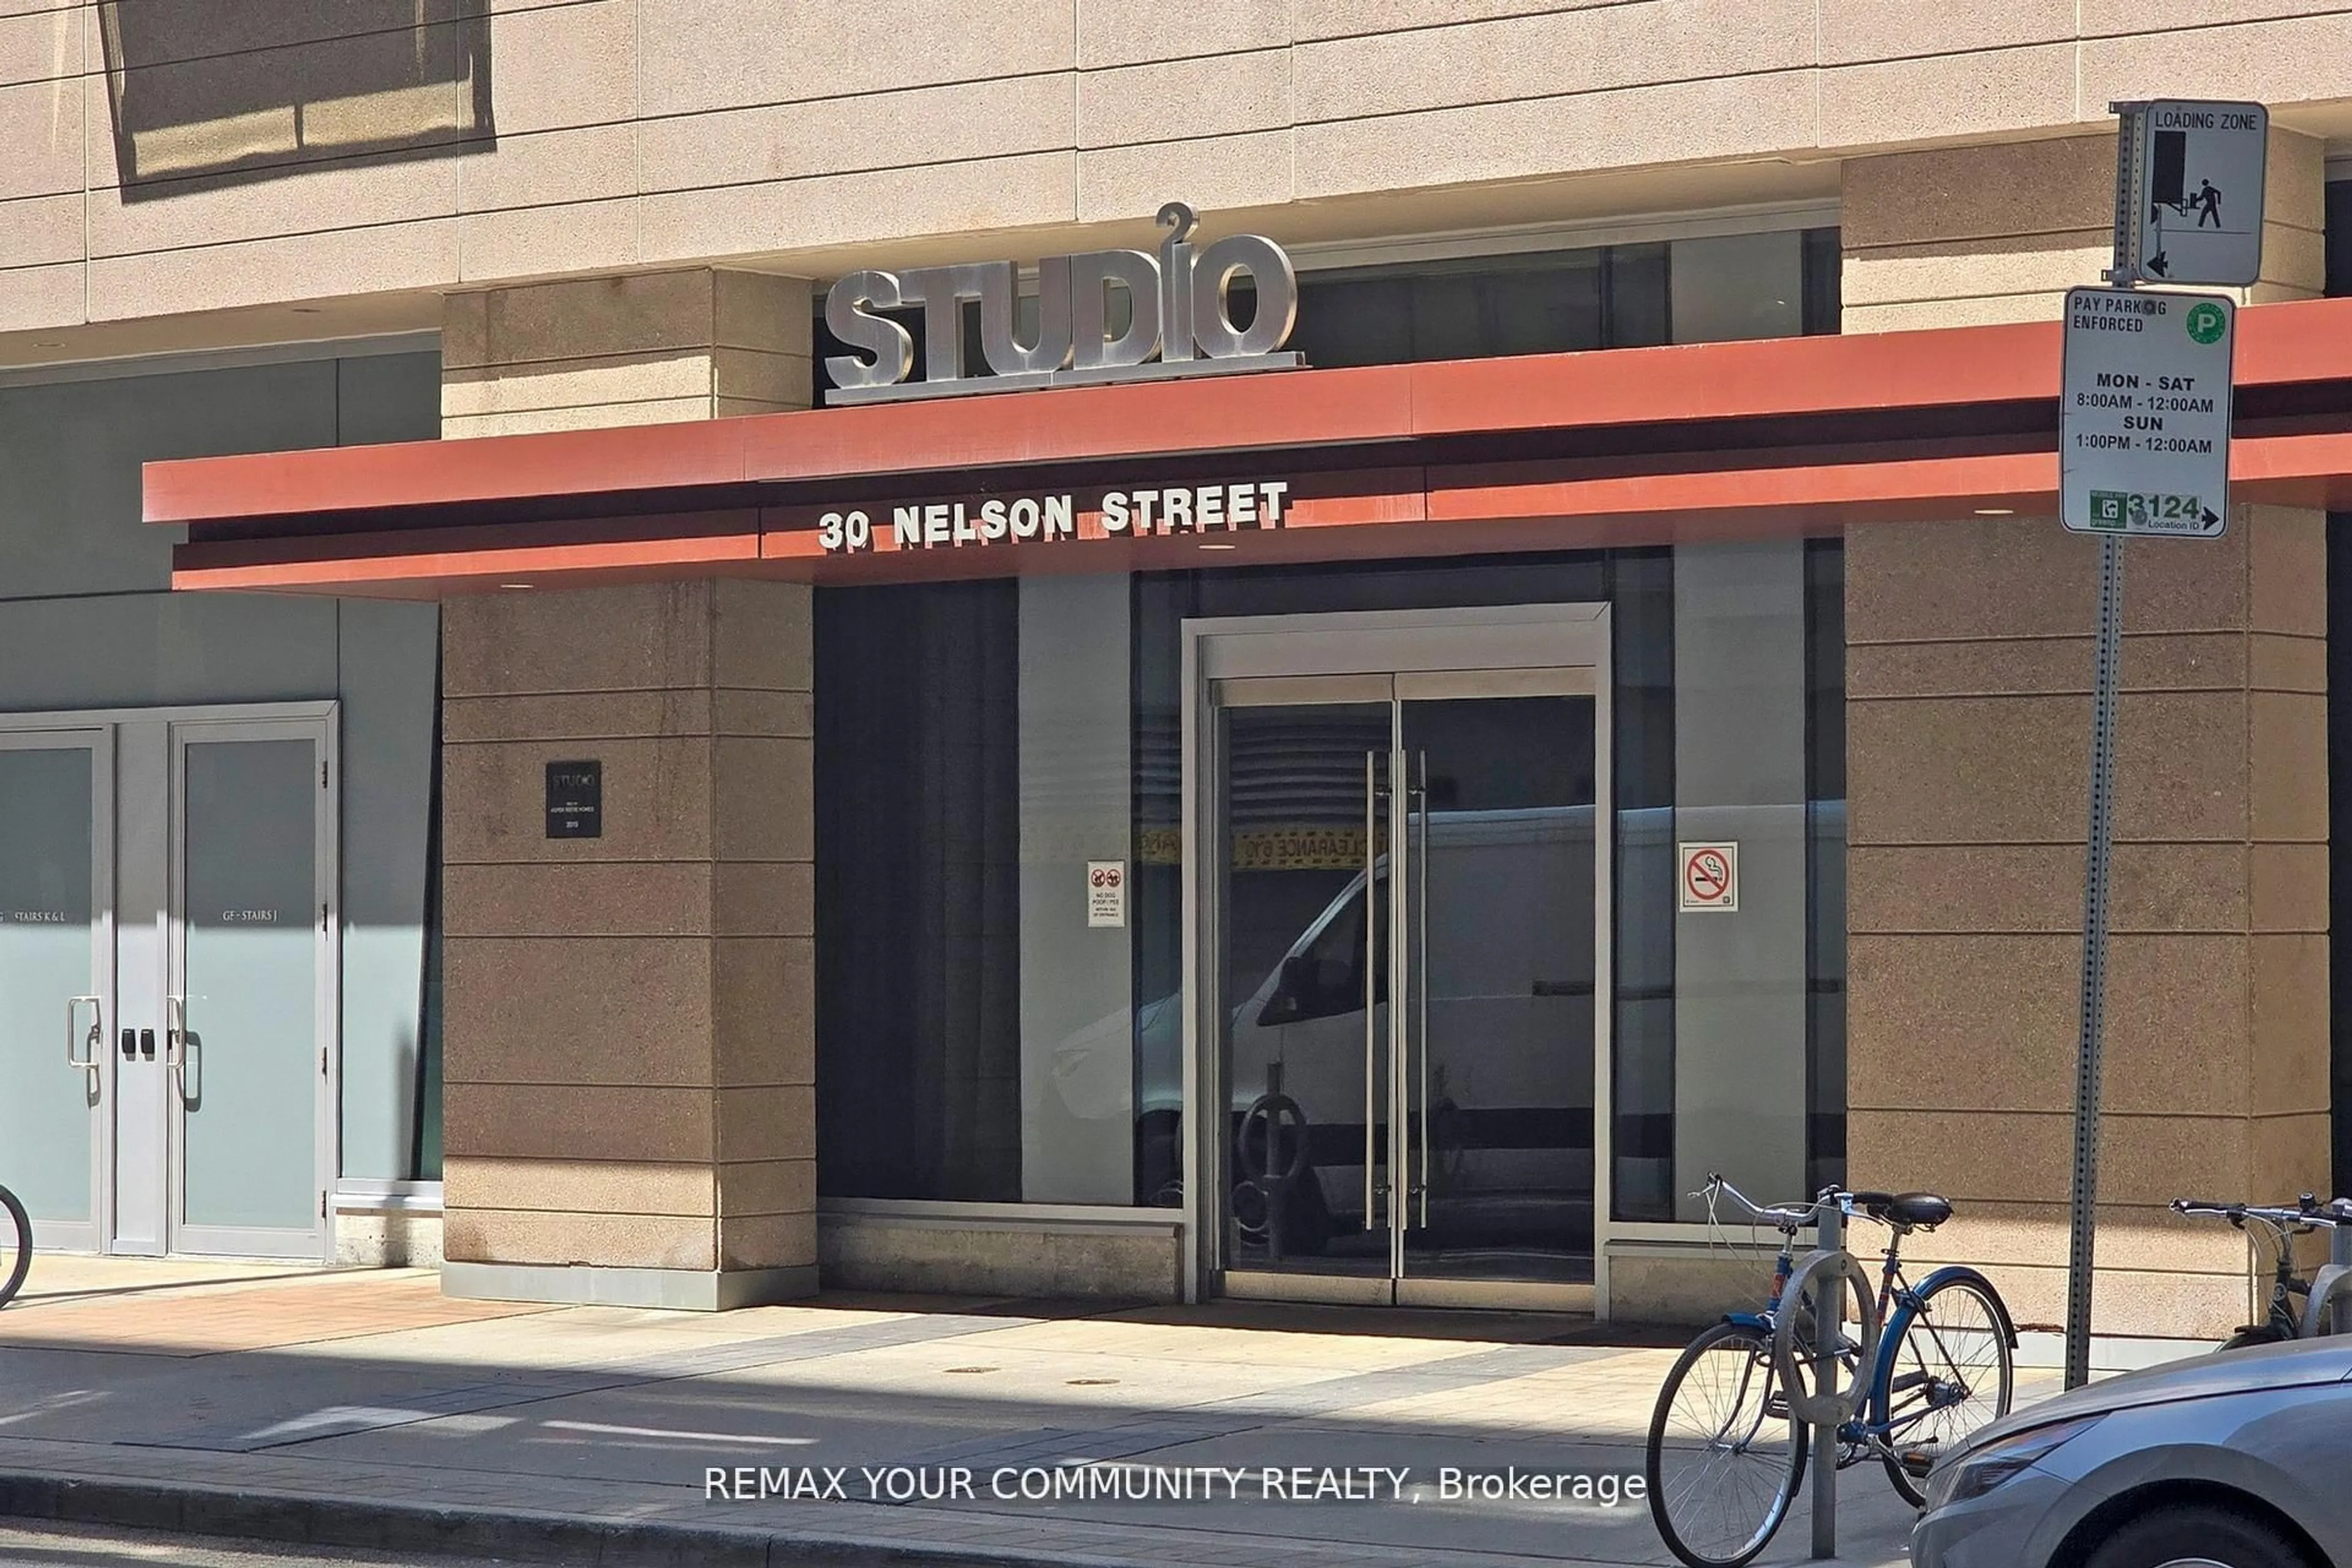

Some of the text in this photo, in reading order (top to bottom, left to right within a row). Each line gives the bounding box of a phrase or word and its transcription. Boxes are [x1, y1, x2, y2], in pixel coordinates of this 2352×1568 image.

[2155, 112, 2257, 130] LOADING ZONE
[2074, 296, 2166, 315] PAY PARKG
[2074, 315, 2143, 332] ENFORCED
[2198, 313, 2216, 333] P
[2097, 373, 2139, 388] MON
[2158, 375, 2195, 391] SAT
[2077, 393, 2132, 410] 8:00AM
[2147, 396, 2214, 413] 12:00AM
[2124, 416, 2163, 431] SUN
[2076, 434, 2130, 450] 1:00PM
[2146, 437, 2212, 453] 12:00AM
[818, 482, 1287, 549] 30 NELSON STREET
[2128, 494, 2199, 519] 3124
[2148, 519, 2199, 530] Location ID
[52, 911, 59, 922] &
[242, 910, 272, 921] STAIRS
